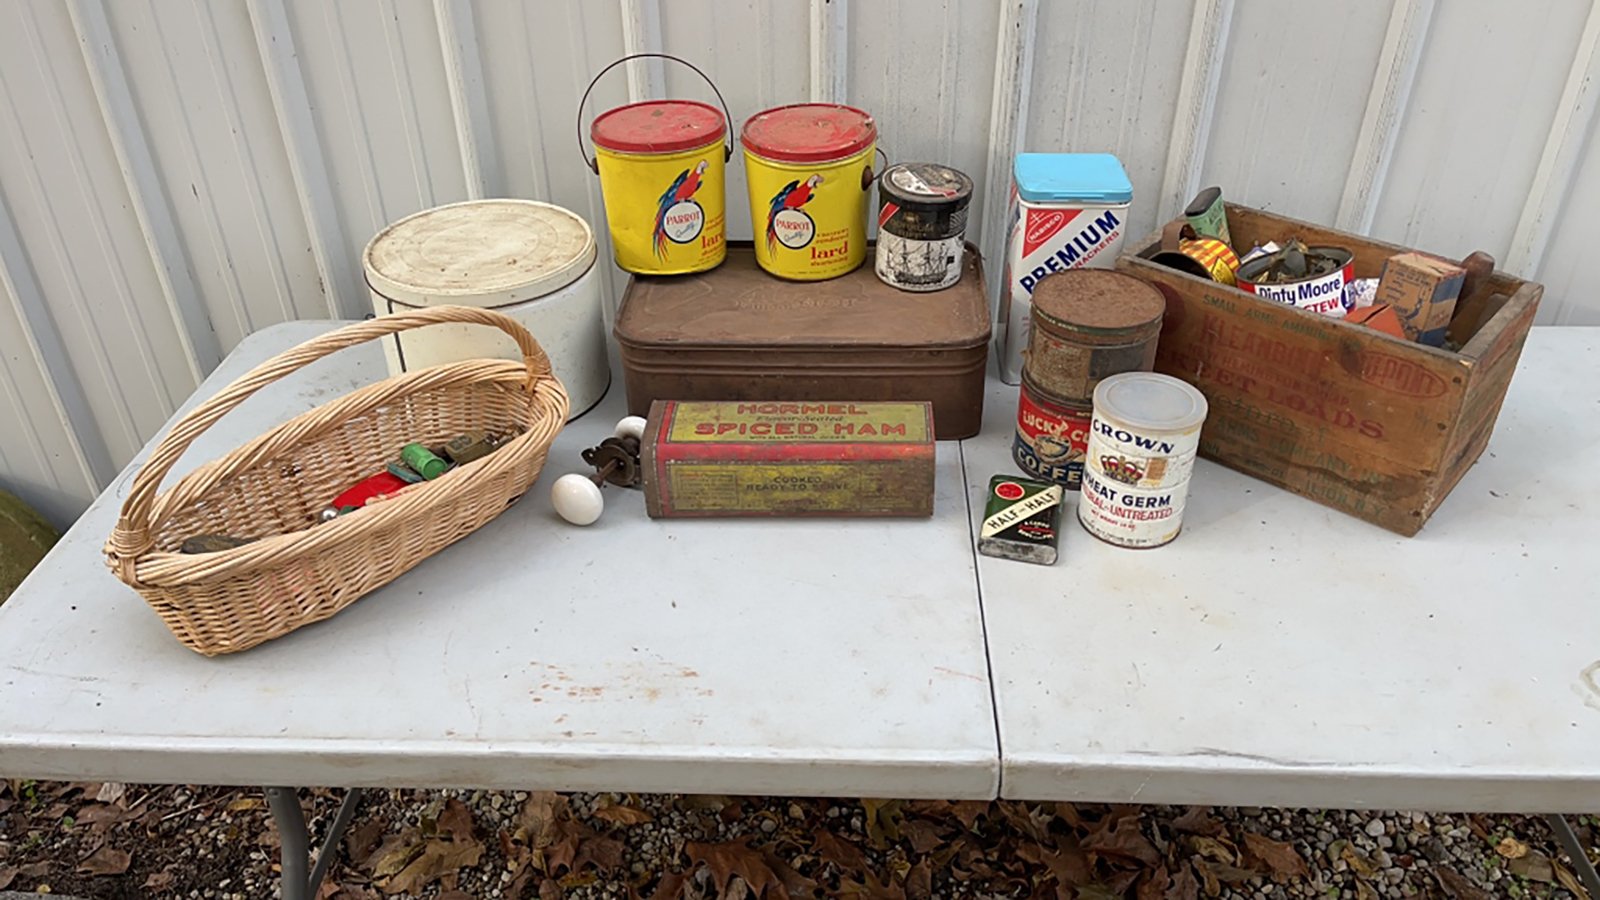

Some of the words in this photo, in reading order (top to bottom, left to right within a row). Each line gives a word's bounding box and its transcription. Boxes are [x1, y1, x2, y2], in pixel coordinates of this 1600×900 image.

[666, 210, 700, 225] PARROT
[775, 218, 810, 231] PARROT
[1029, 214, 1061, 241] NABISCO
[702, 233, 723, 249] lar
[810, 240, 848, 260] lard
[1019, 209, 1120, 295] PREMIUM
[1071, 230, 1119, 269] RACKERS
[1259, 286, 1296, 306] Dinty
[1298, 278, 1341, 300] Moore
[1204, 294, 1237, 314] SMALL
[1244, 307, 1276, 325] ARMS
[737, 403, 868, 415] HORMEL
[1267, 387, 1384, 439] LOADS
[694, 422, 818, 435] SPICED
[834, 422, 906, 436] HAM
[1093, 419, 1174, 454] CROWN
[1018, 446, 1081, 482] COFFE
[773, 476, 822, 484] COOKED
[1082, 471, 1118, 501] WHEAT
[1121, 494, 1171, 508] GERM
[987, 509, 1019, 530] HALF
[1024, 492, 1056, 511] HALF
